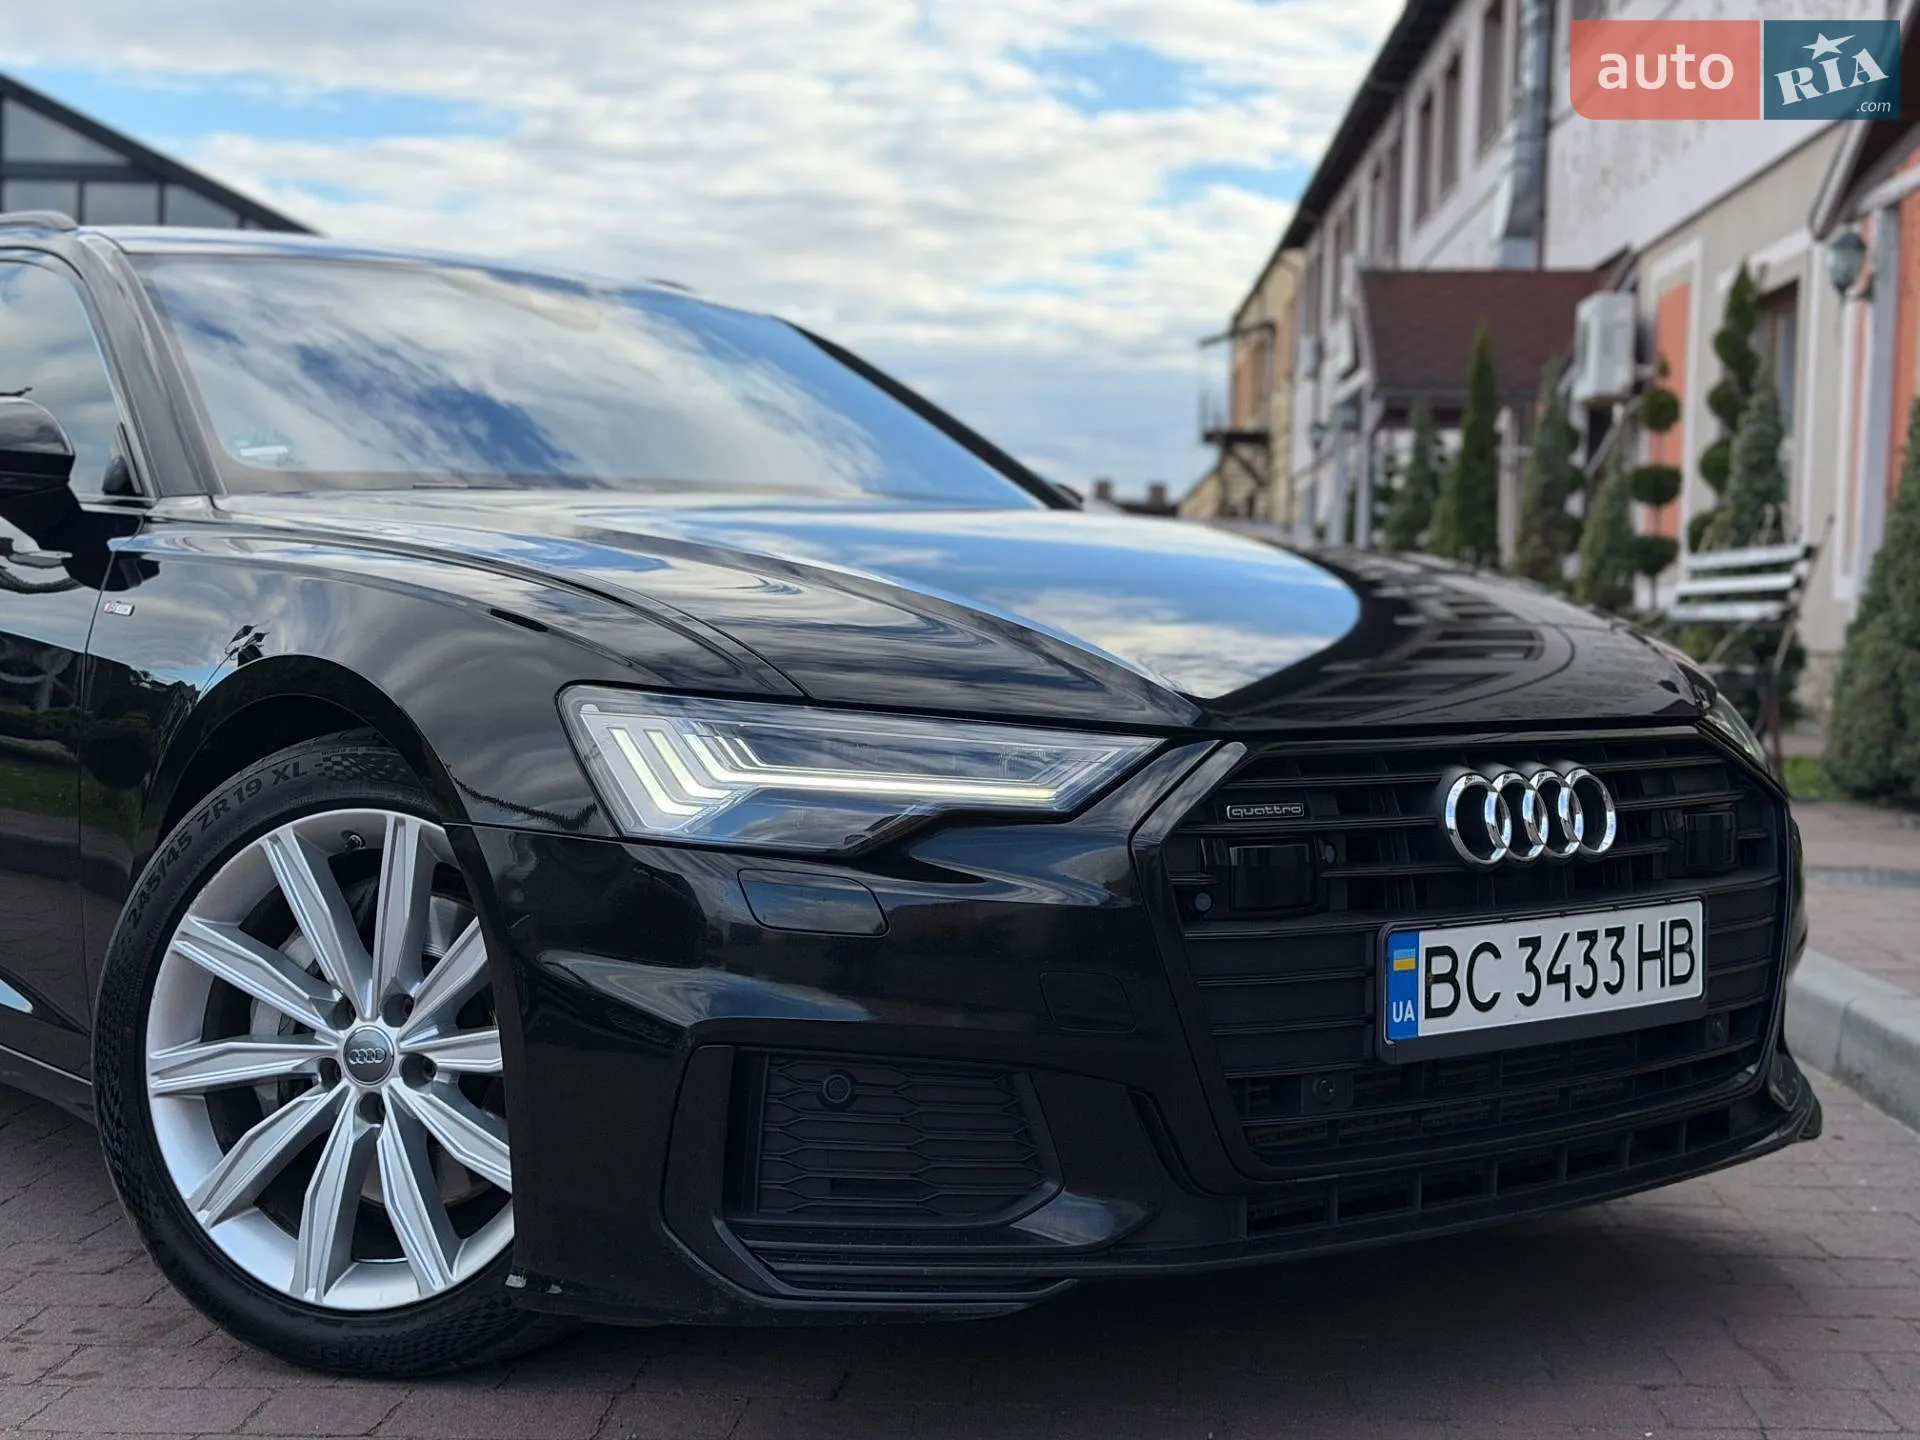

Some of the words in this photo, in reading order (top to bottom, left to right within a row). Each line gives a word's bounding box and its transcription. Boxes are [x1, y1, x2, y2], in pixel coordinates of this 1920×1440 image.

[1231, 805, 1302, 818] quattro
[128, 830, 192, 929] 245/45
[197, 798, 231, 833] ZR
[233, 778, 263, 804] 19
[271, 761, 308, 785] XL
[1424, 941, 1502, 1019] BC
[1516, 925, 1626, 1008] 3433
[1637, 918, 1695, 992] HB
[1392, 1001, 1415, 1024] UA
